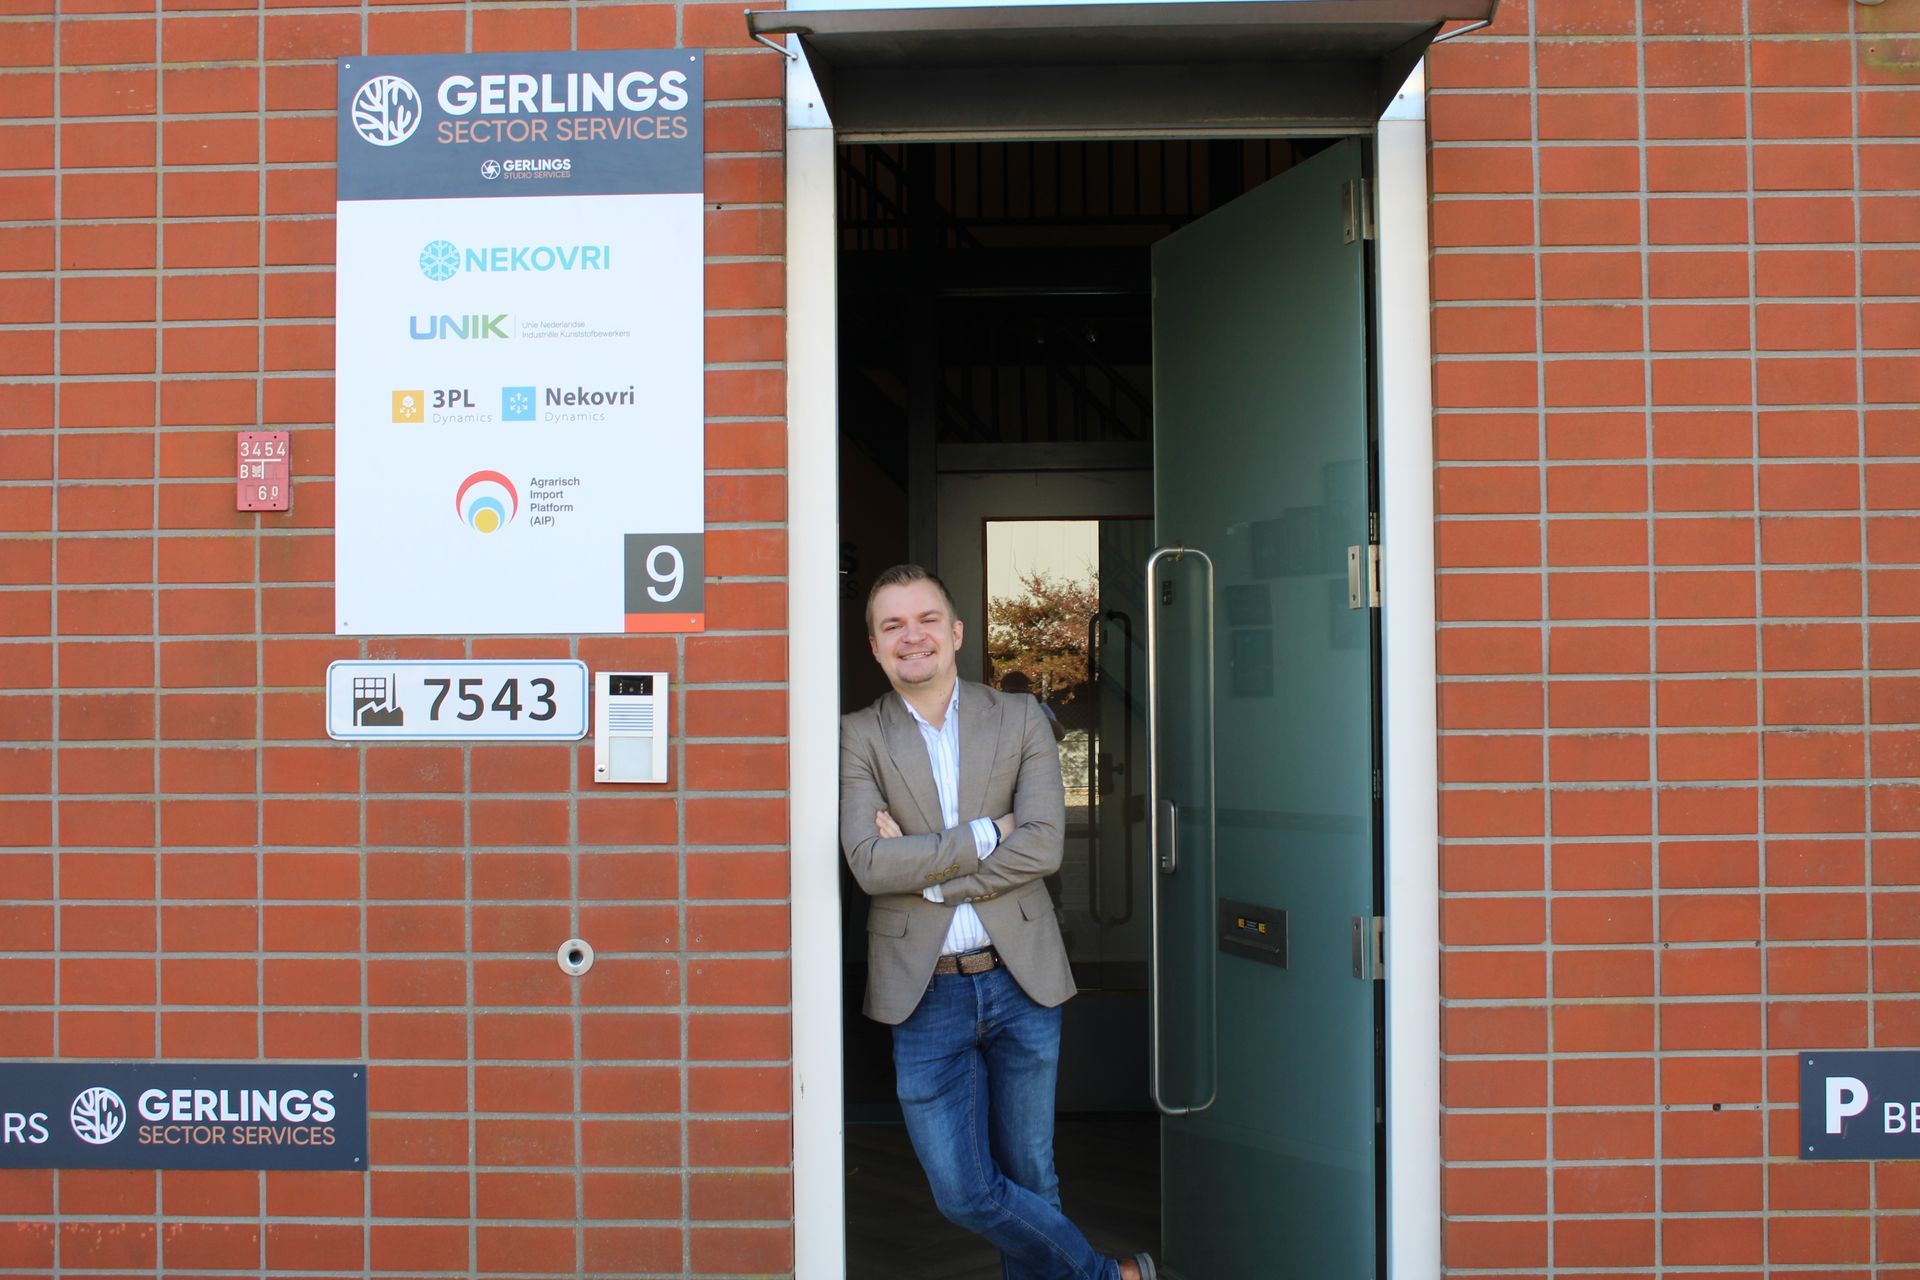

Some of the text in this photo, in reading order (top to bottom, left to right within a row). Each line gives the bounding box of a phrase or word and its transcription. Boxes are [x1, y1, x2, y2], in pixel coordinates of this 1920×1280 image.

[437, 70, 689, 116] GERLINGS
[437, 116, 689, 144] SECTOR SERVICES
[503, 158, 571, 171] GERLINGS
[504, 170, 571, 180] STUDIO SERVICES
[465, 245, 610, 272] NEKOVRI
[409, 313, 510, 340] UNIK
[521, 319, 586, 329] Unie Nederlandse
[432, 389, 476, 408] 3PL
[545, 385, 635, 406] Nekovri
[432, 412, 493, 425] Dynamics
[544, 411, 606, 424] Dynamics
[240, 441, 286, 457] 3454
[529, 476, 581, 488] Agrarisch
[529, 489, 564, 501] Import
[529, 502, 574, 514] Platform
[529, 515, 556, 528] (AIP)
[645, 544, 685, 603] 9
[423, 677, 557, 722] 7543
[138, 1088, 337, 1123] GERLINGS
[1825, 1076, 1869, 1134] P
[4, 1112, 49, 1144] RS
[138, 1125, 336, 1145] SECTOR SERVICES
